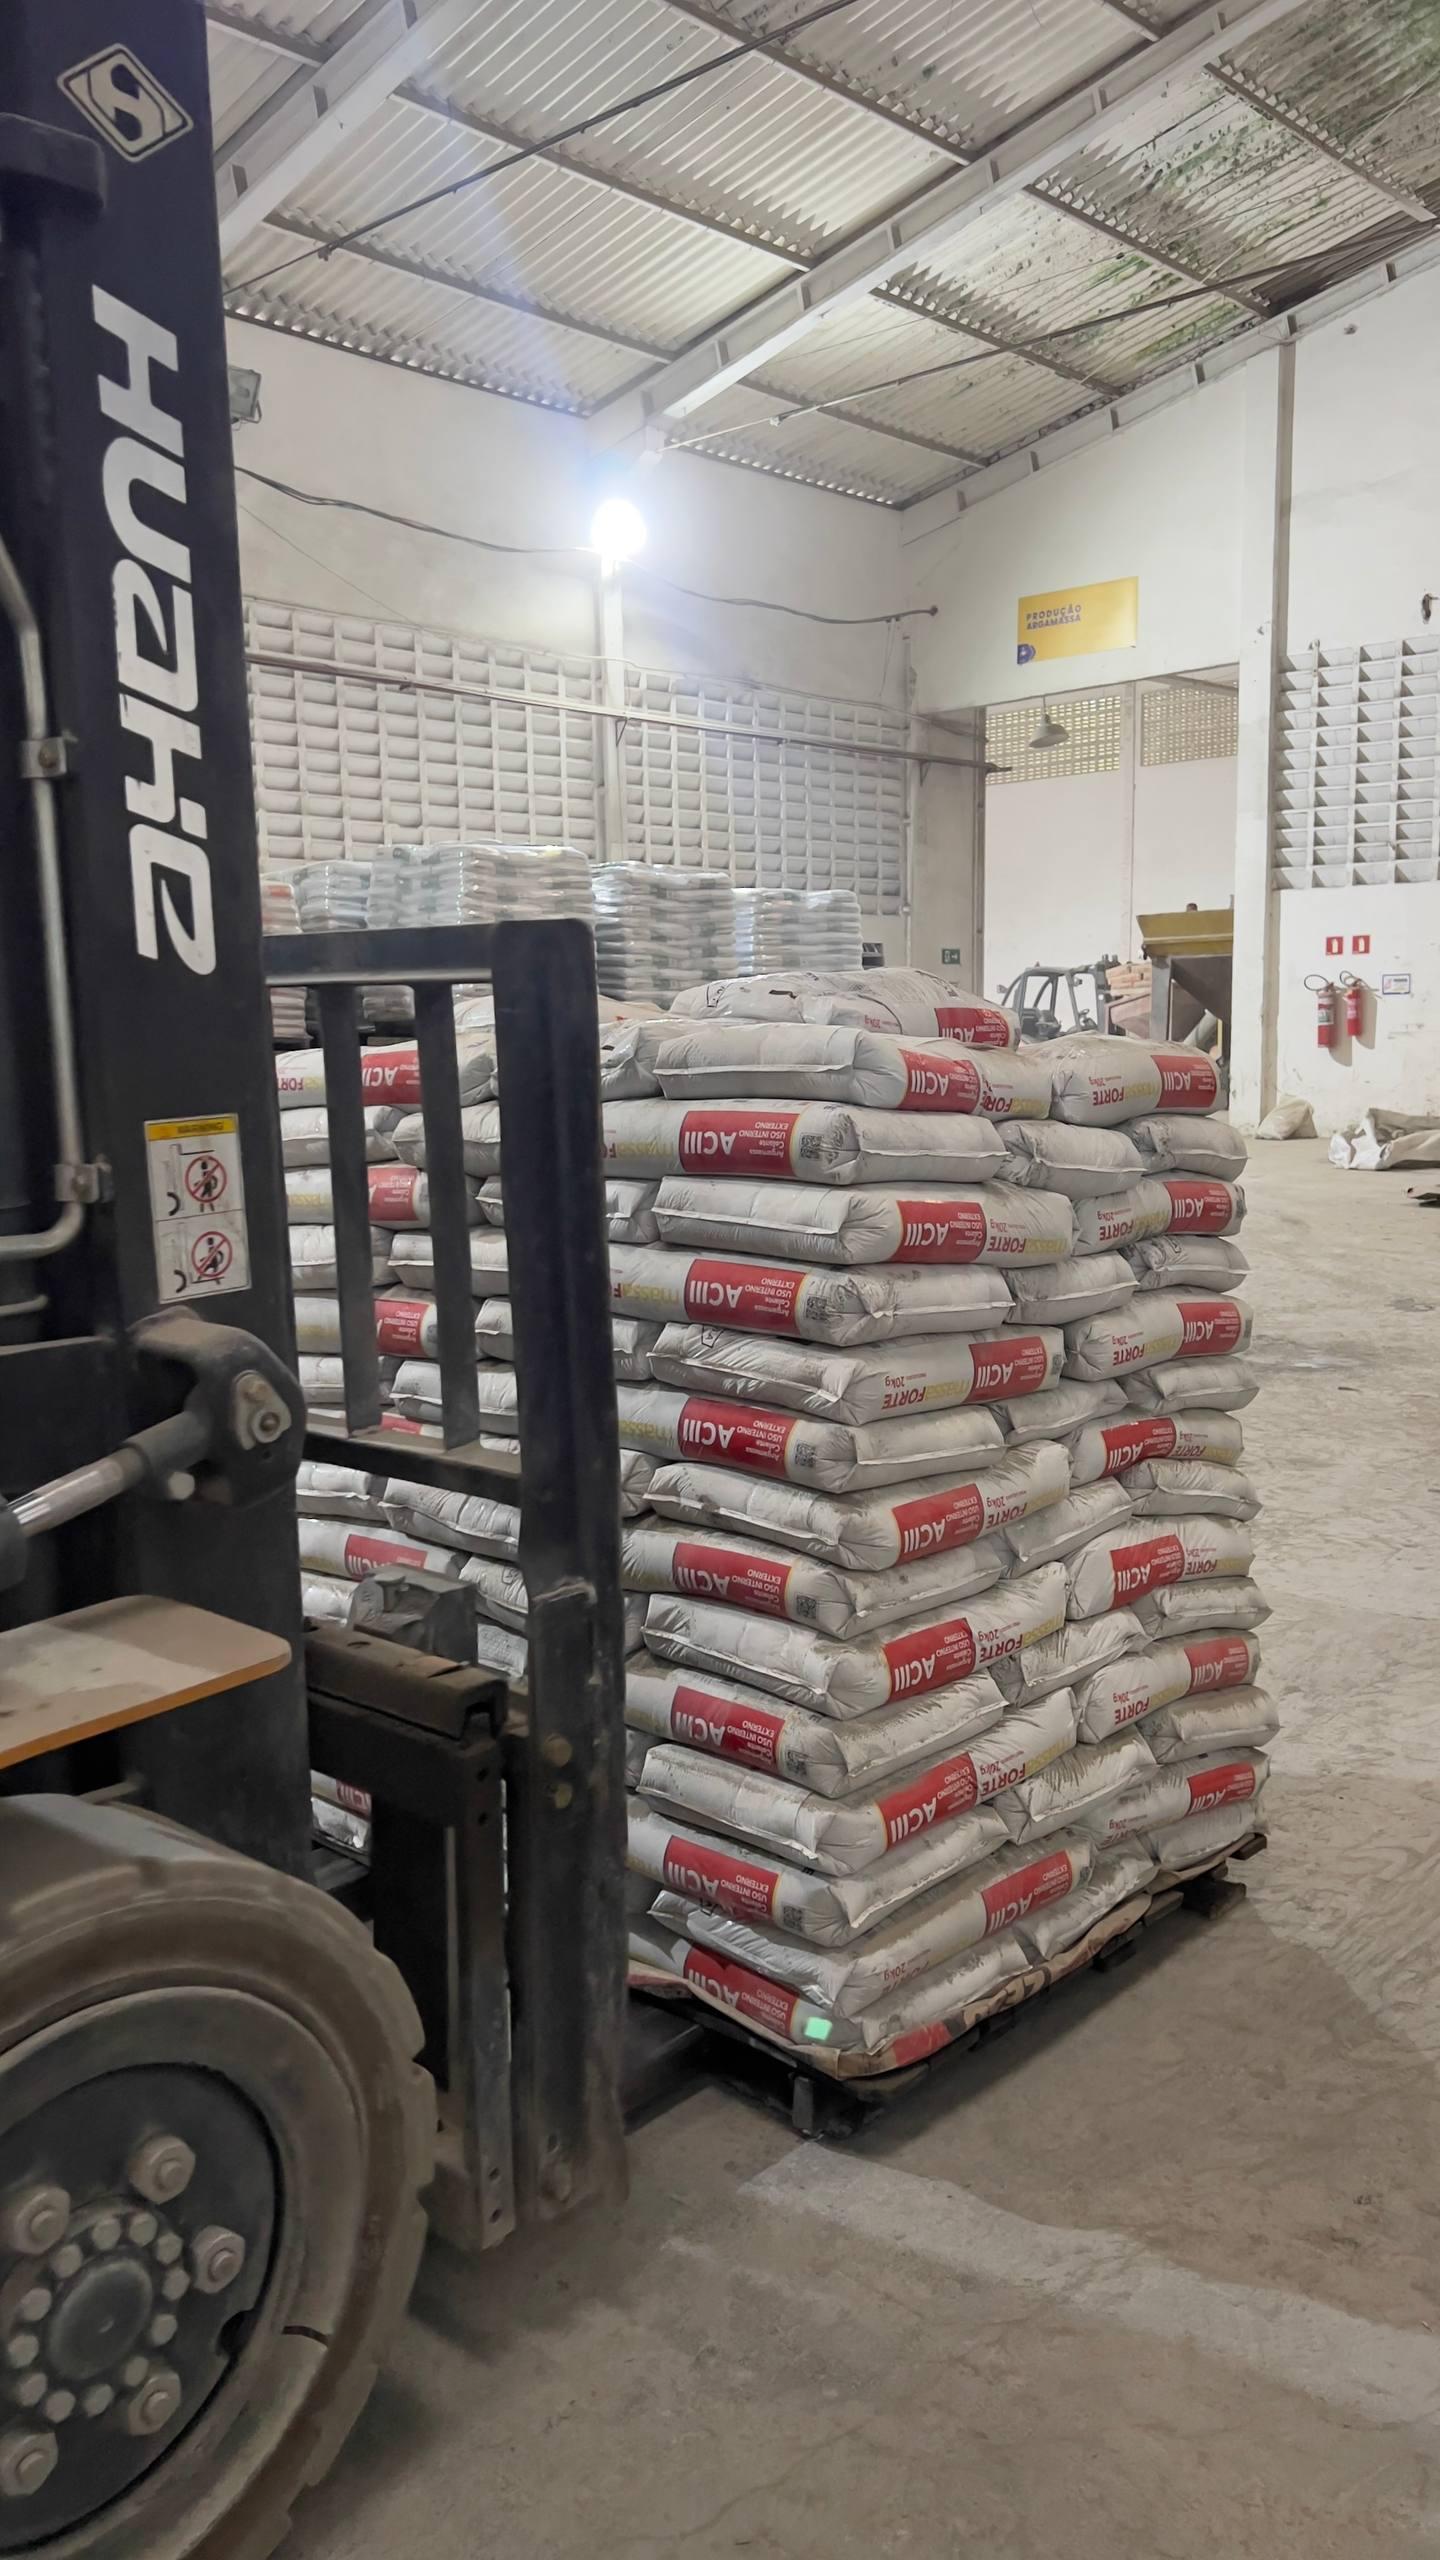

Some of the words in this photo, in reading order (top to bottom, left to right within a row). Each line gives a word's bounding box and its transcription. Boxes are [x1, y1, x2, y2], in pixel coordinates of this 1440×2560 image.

[1026, 604, 1082, 620] PRODUÇÃO
[1026, 614, 1081, 630] ARGAMASSA
[911, 1070, 949, 1096] ACIII
[1163, 1071, 1191, 1091] ACIII
[1093, 1086, 1124, 1106] FORTE
[739, 1130, 768, 1139] INTERNO
[755, 1121, 788, 1130] EXTERNO
[685, 1131, 737, 1155] ACIII
[758, 1140, 784, 1149] Colante
[769, 1131, 786, 1140] USO
[1097, 1211, 1114, 1220] 20kg
[1175, 1199, 1204, 1218] ACIII
[905, 1223, 949, 1246] ACIII
[1099, 1220, 1134, 1241] FORTE
[988, 1236, 1026, 1253] FORTE
[745, 1285, 773, 1296] INTERNO
[761, 1277, 795, 1289] EXTERNO
[690, 1280, 744, 1309] ACIII
[775, 1288, 792, 1298] USO
[1112, 1335, 1129, 1345] 20kg
[1185, 1320, 1215, 1343] ACIII
[1113, 1344, 1145, 1366] FORTE
[885, 1375, 905, 1388] 20kg
[976, 1362, 1013, 1388] ACIII
[882, 1387, 926, 1409] FORTE
[682, 1419, 735, 1449] ACIII
[736, 1425, 765, 1439] INTERNO
[753, 1420, 786, 1434] EXTERNO
[766, 1432, 783, 1442] USO
[1108, 1442, 1143, 1469] ACIII
[954, 1496, 977, 1509] EXTERNO
[987, 1497, 1005, 1508] 20kg
[986, 1503, 1027, 1529] FORTE
[904, 1519, 945, 1553] ACIII
[747, 1568, 782, 1585] EXTERNO
[1185, 1560, 1217, 1576] FORTE
[677, 1566, 730, 1596] ACIII
[732, 1575, 763, 1590] INTERNO
[1117, 1563, 1151, 1592] ACIII
[763, 1582, 780, 1594] USO
[978, 1629, 999, 1642] 20kg
[980, 1634, 1023, 1663] FORTE
[895, 1654, 935, 1692] ACIII
[1193, 1661, 1223, 1686] ACIII
[1112, 1691, 1130, 1705] 20kg
[1114, 1697, 1150, 1725] FORTE
[675, 1711, 726, 1746] ACIII
[742, 1720, 775, 1737] EXTERNO
[757, 1735, 773, 1747] USO
[980, 1763, 1026, 1796] FORTE
[1189, 1788, 1226, 1815] ACIII
[891, 1798, 936, 1843] ACIII
[668, 1861, 719, 1896] ACIII
[1042, 1864, 1067, 1881] EXTERNO
[720, 1879, 751, 1897] INTERNO
[736, 1874, 769, 1892] EXTERNO
[752, 1889, 767, 1902] USO
[988, 1892, 1033, 1934] ACIII
[884, 1963, 906, 1981] 20kg
[688, 1969, 740, 2009] ACIII
[756, 1988, 789, 2011] EXTERNO
[769, 2007, 786, 2021] USO
